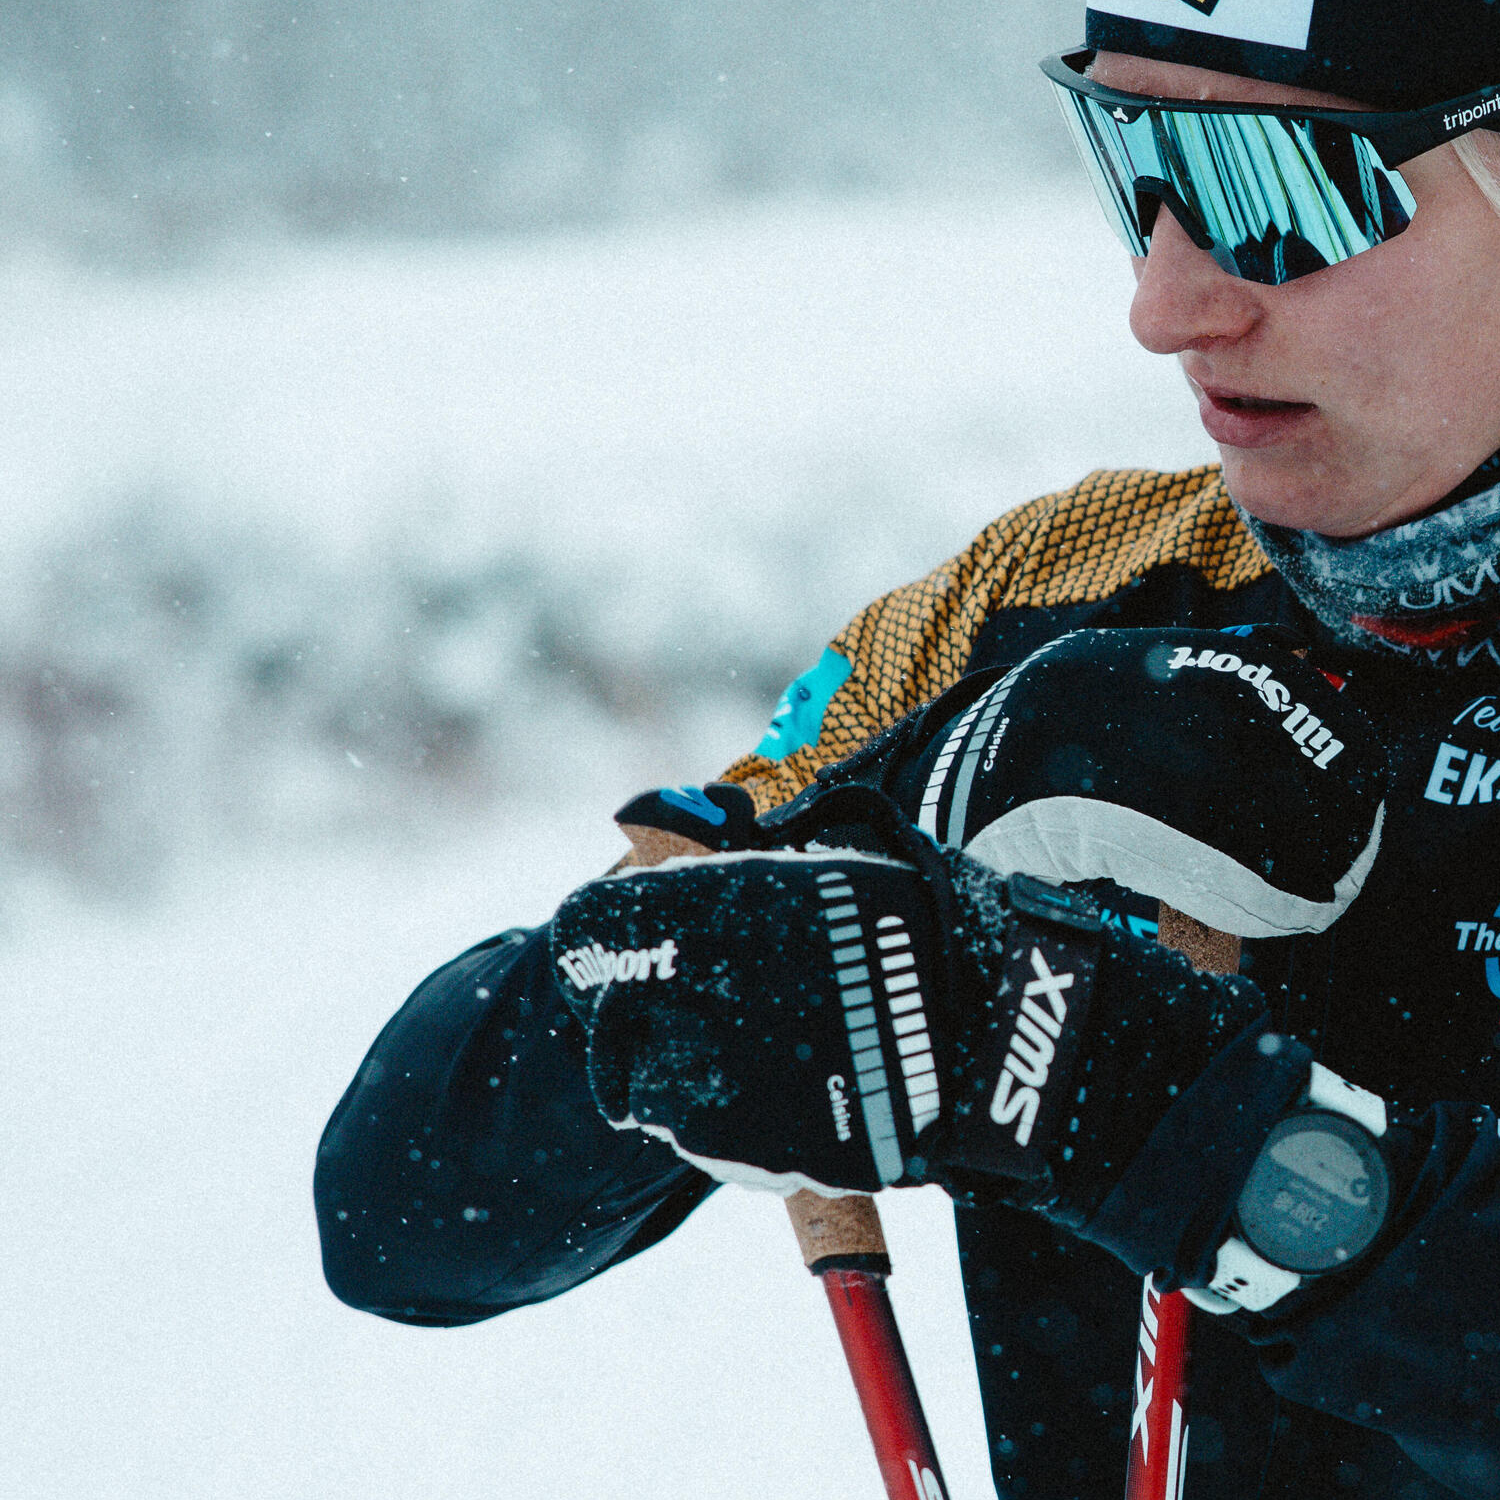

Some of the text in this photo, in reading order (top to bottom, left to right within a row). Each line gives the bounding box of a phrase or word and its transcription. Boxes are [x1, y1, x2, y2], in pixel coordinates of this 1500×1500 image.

[983, 716, 1010, 772] Celsius
[990, 946, 1075, 1148] SWIX
[827, 1074, 852, 1142] Celsius
